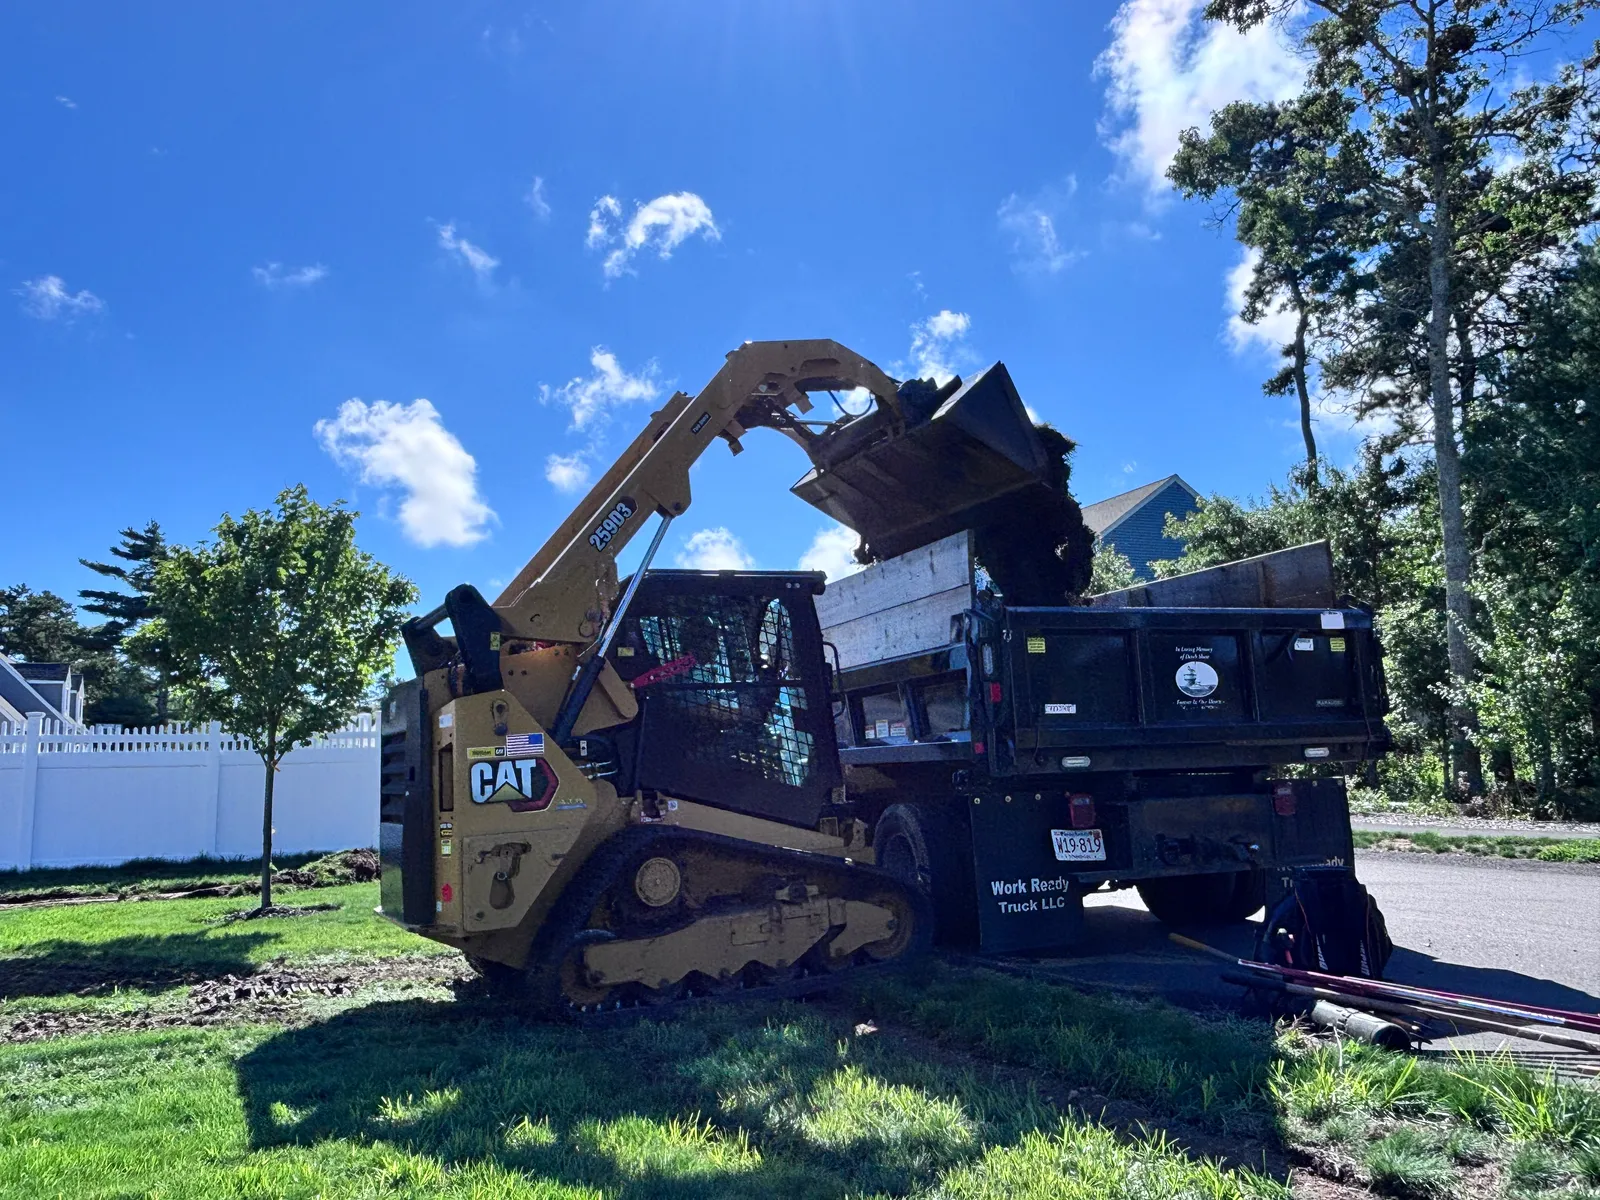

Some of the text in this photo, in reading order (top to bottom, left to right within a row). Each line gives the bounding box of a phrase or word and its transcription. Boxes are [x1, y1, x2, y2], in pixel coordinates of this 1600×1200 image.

[589, 502, 632, 551] 259D3
[471, 759, 536, 803] CAT
[991, 876, 1069, 896] Work Ready
[998, 896, 1065, 914] Truck LLC
